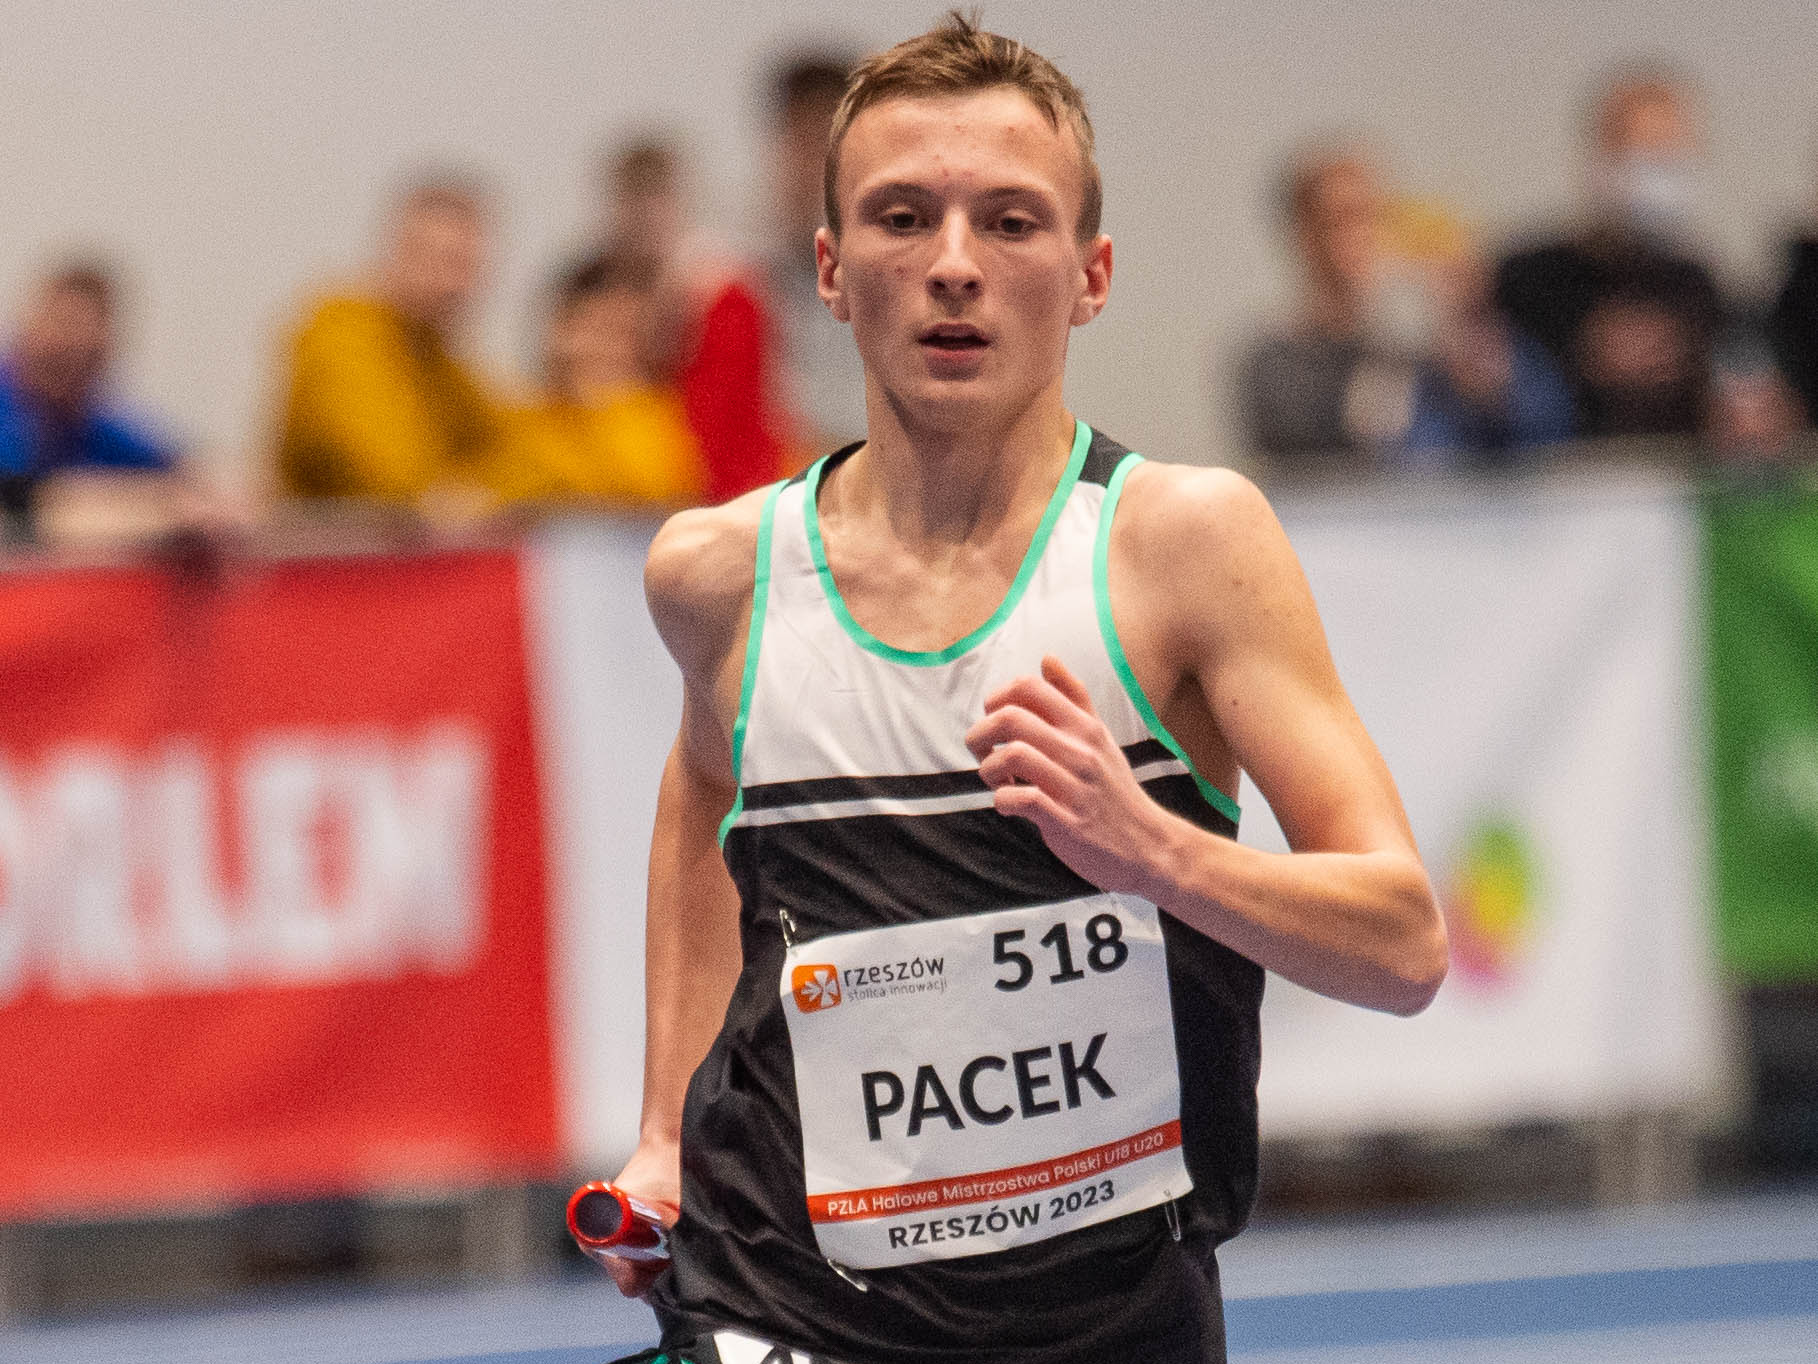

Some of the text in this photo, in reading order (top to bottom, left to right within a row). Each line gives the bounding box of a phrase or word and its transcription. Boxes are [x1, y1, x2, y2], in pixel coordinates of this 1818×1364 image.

[843, 956, 945, 987] rzeszów
[992, 913, 1129, 993] 518
[860, 1032, 1117, 1142] PACEK
[827, 1132, 1164, 1217] PZLA Halowe Mistrzostwa Polski U18 U20
[888, 1180, 1116, 1249] RZESZÓW 2023
